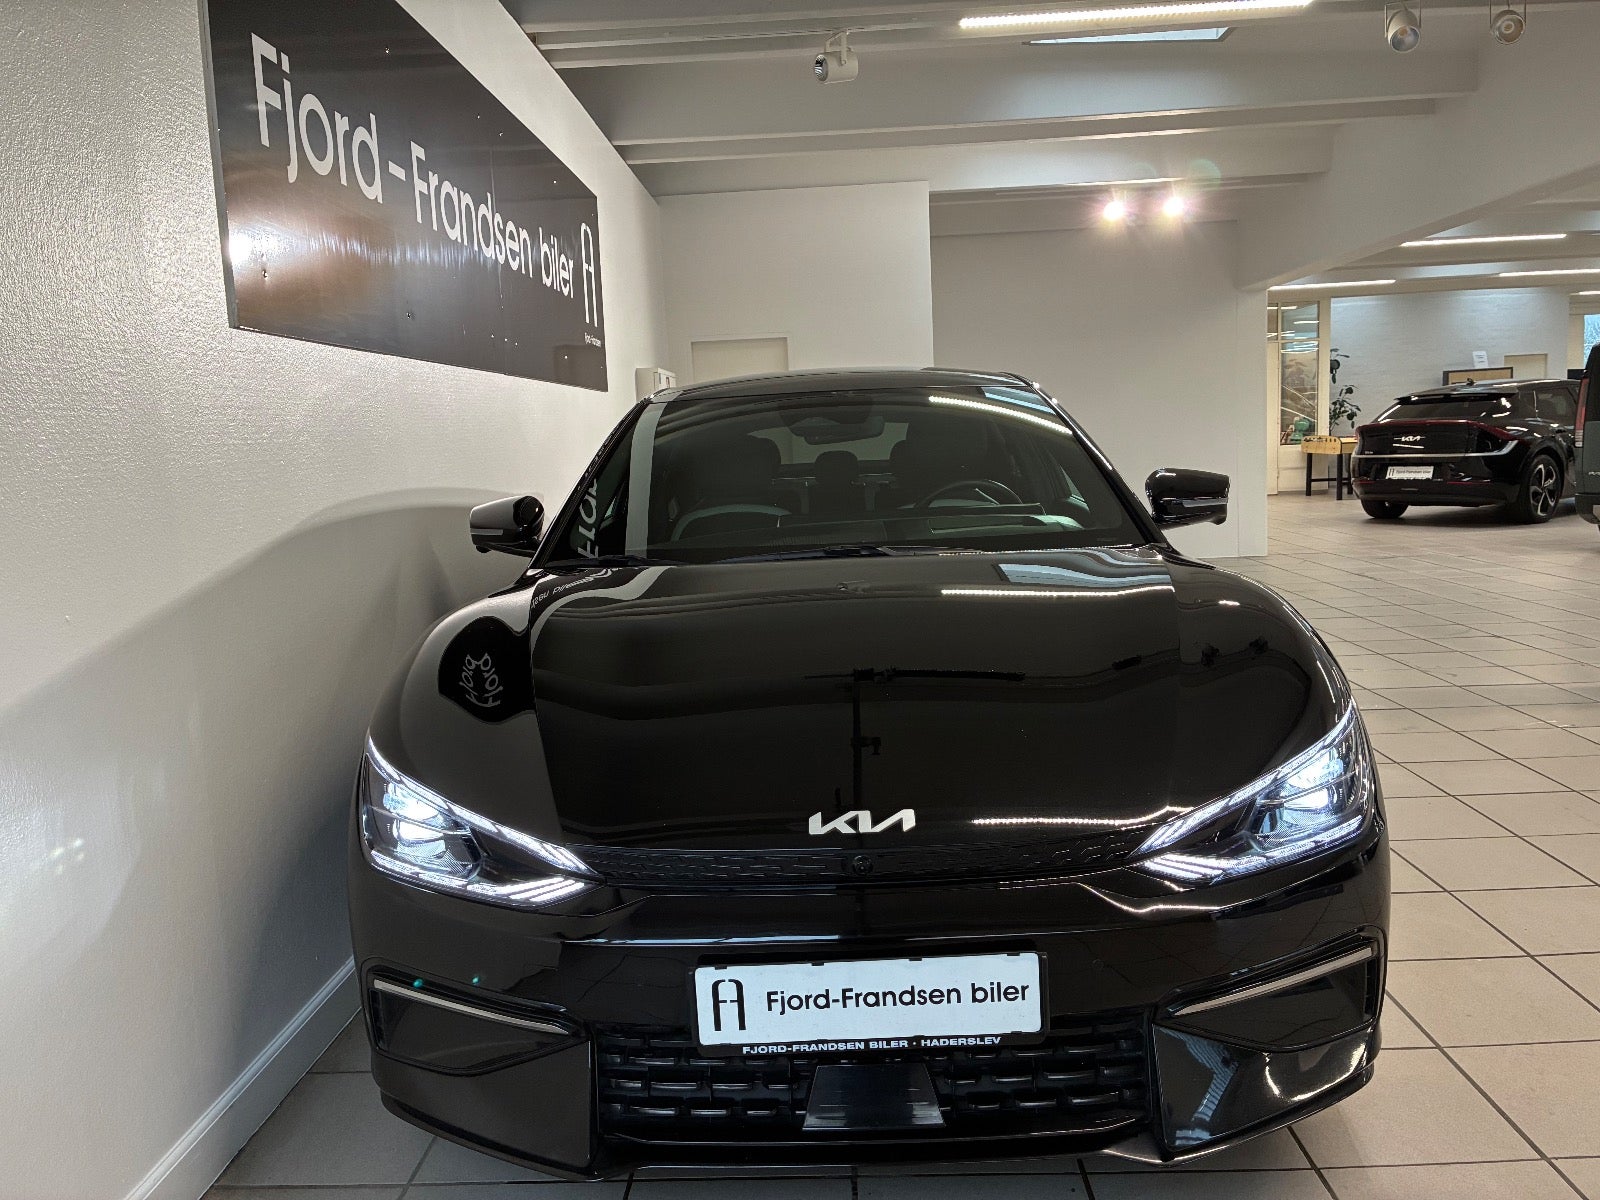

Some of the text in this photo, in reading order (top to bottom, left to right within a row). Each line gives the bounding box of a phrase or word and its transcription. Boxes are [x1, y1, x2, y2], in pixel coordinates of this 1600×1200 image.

[251, 32, 574, 299] Fjord-Frandsen biler
[808, 808, 916, 835] KIA
[766, 981, 1030, 1016] Fjord-Frandsen biler
[742, 1036, 1002, 1055] FJORD-FRANDSEN BILER HADERSLEV
